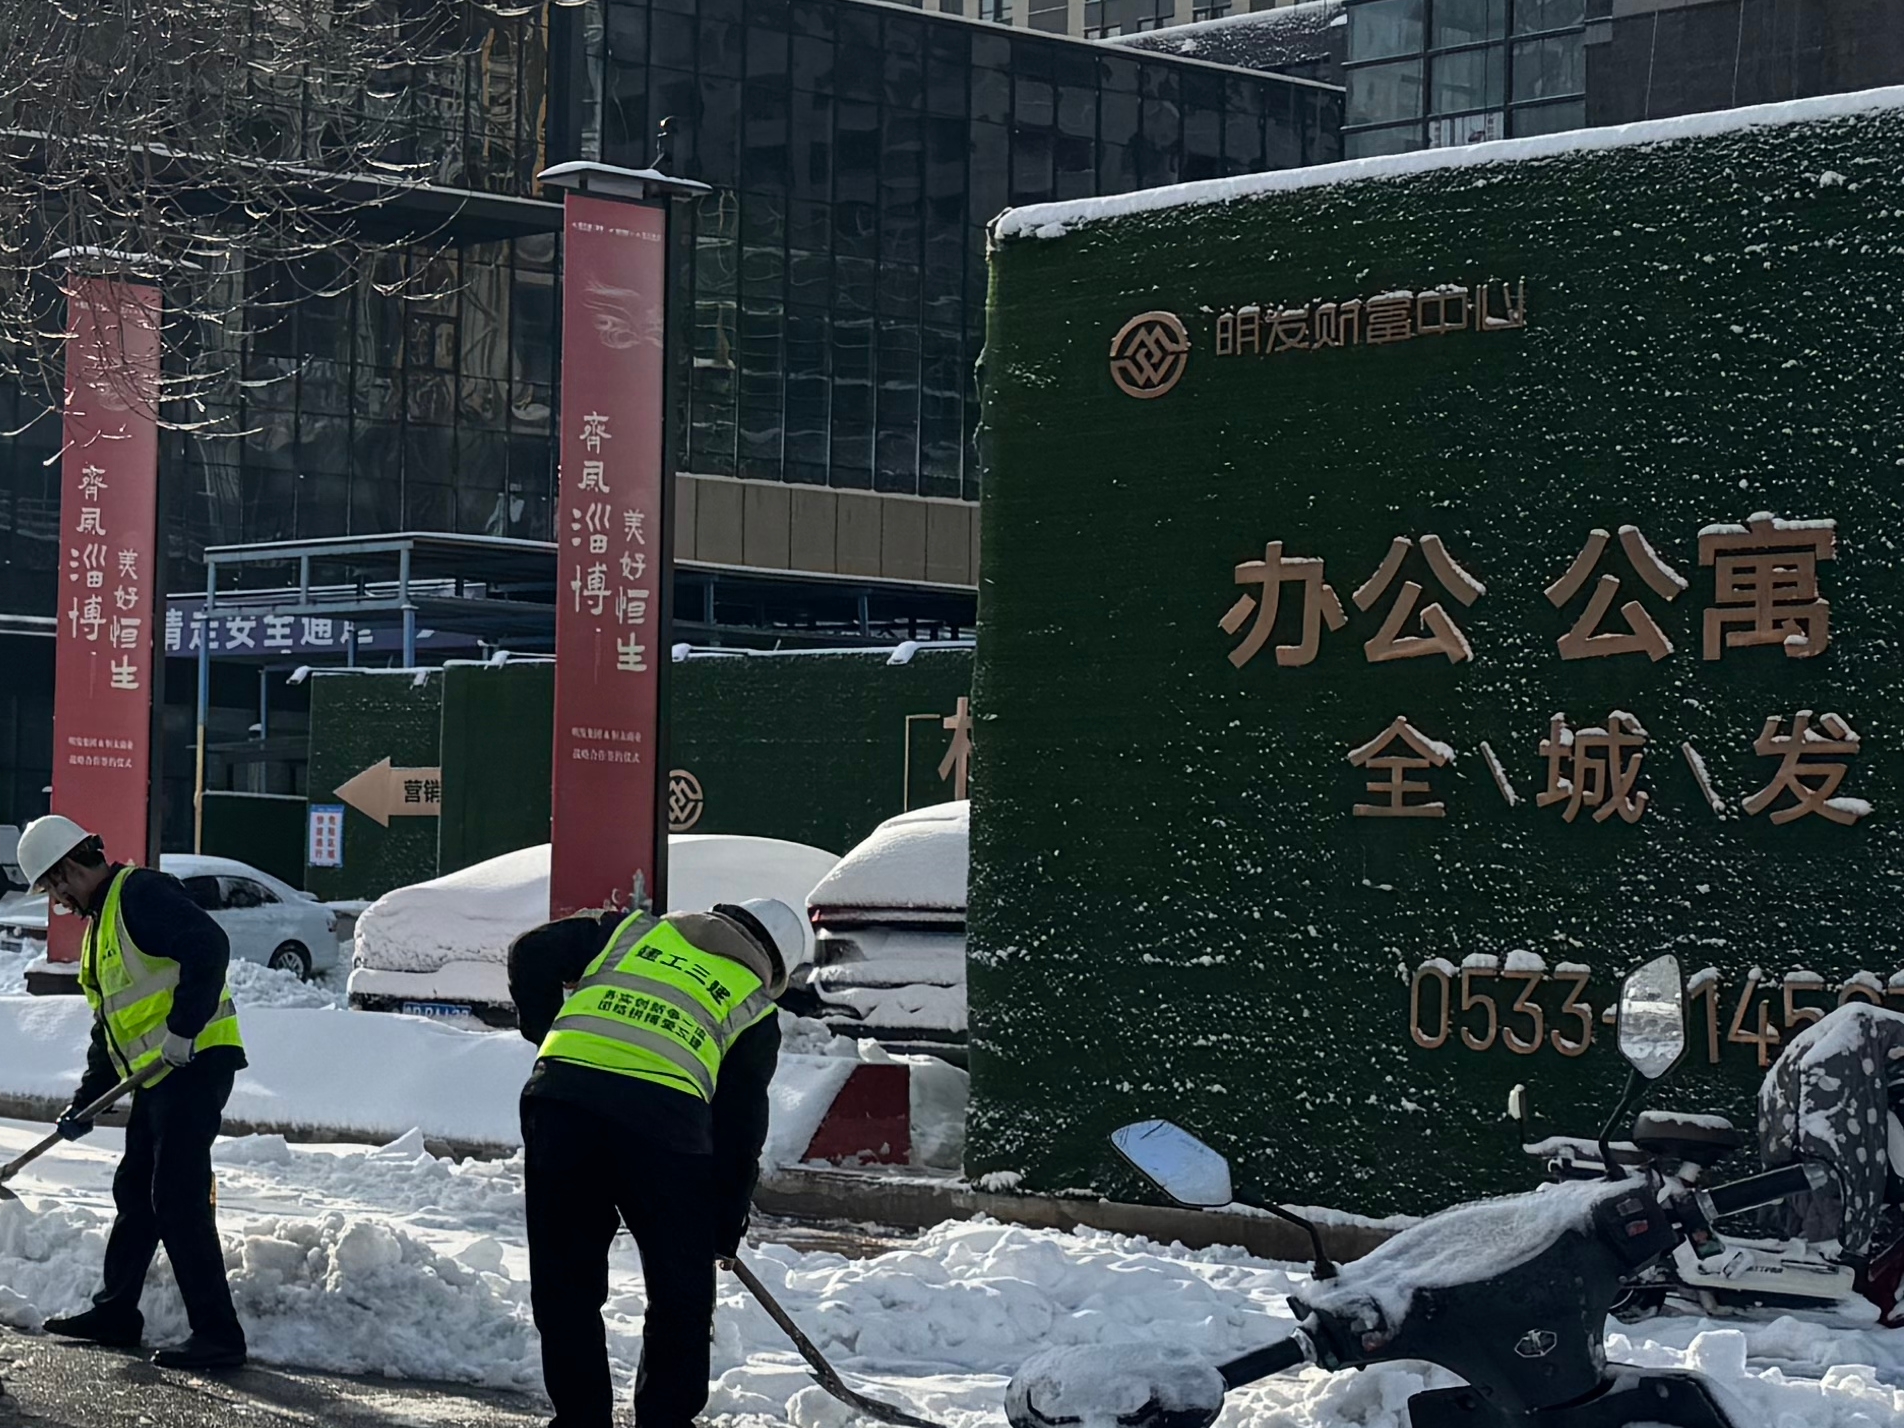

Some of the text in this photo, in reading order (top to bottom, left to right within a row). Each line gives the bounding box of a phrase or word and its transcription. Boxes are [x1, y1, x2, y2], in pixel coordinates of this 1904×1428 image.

[1216, 276, 1525, 356] 明发财富中心
[110, 549, 140, 690] 美好恒生
[616, 509, 650, 672] 美好恒生
[1219, 512, 1836, 668] 办公 公寓
[635, 945, 731, 1006] 建工三建
